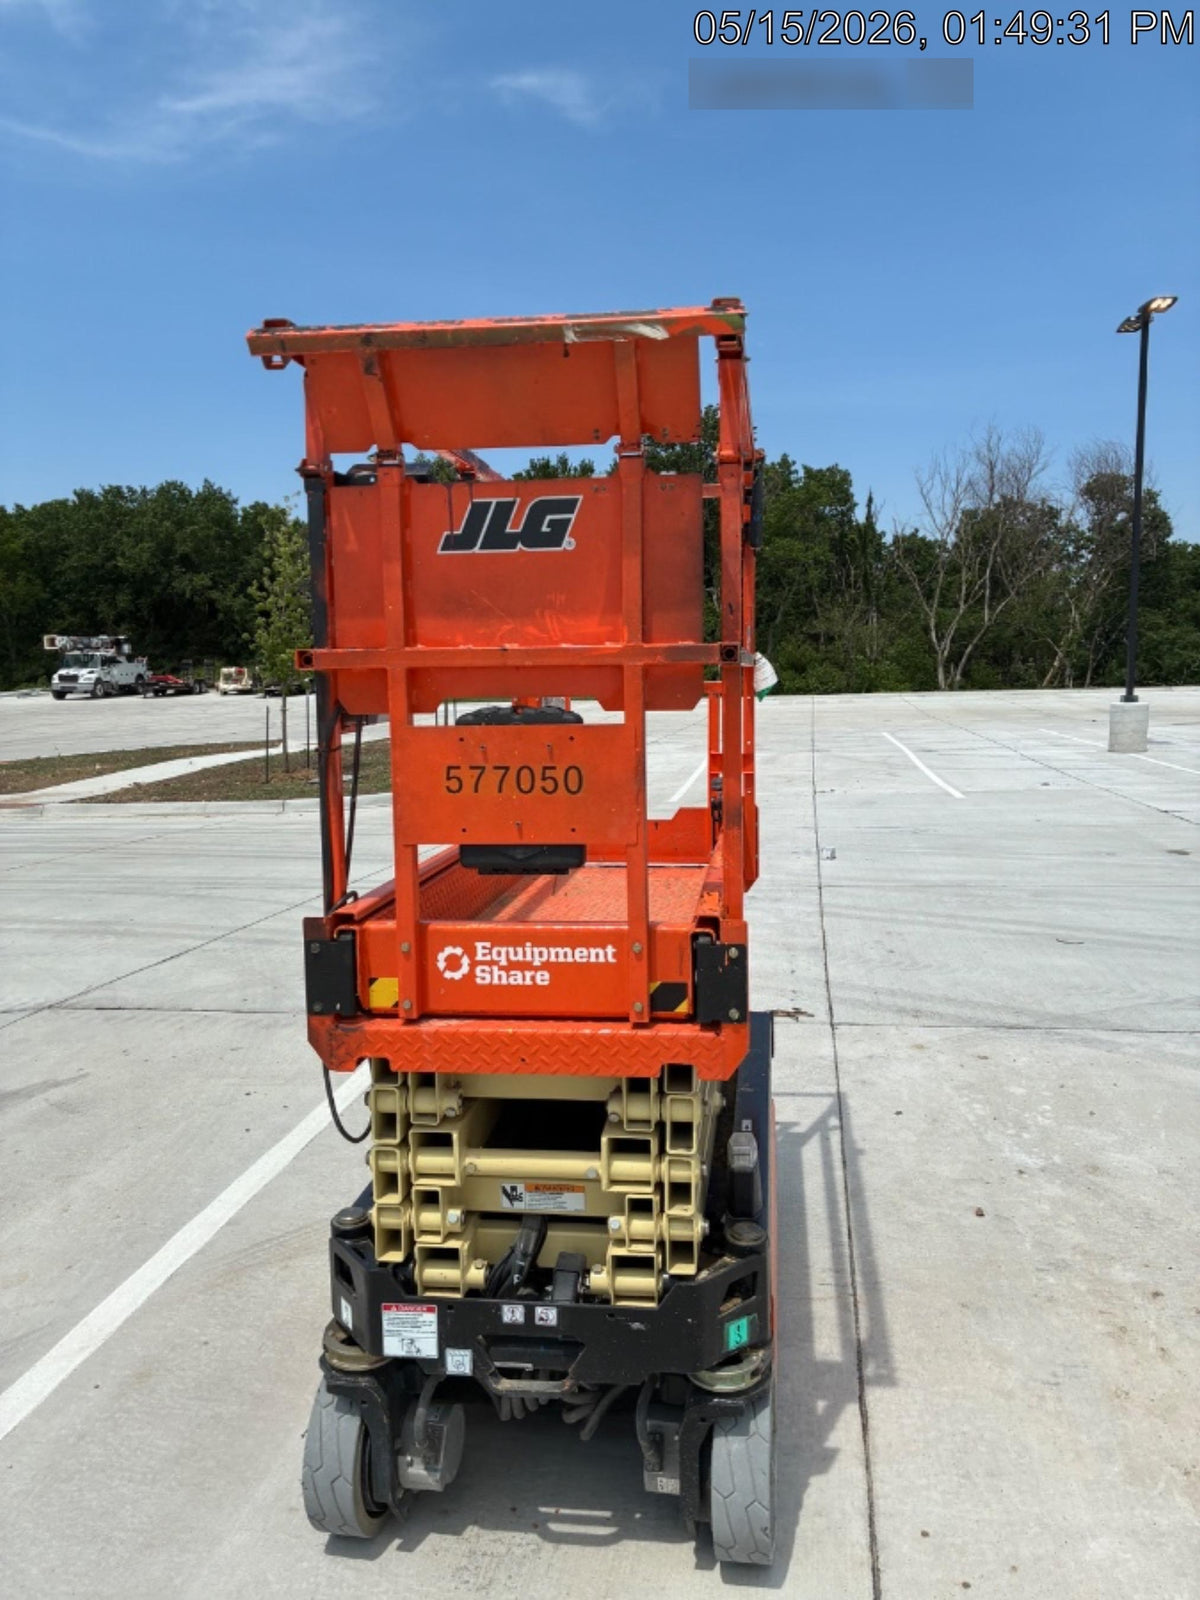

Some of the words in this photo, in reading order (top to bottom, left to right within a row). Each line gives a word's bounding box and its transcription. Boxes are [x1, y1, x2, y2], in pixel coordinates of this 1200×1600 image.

[437, 495, 583, 553] JLG
[445, 765, 584, 795] 577050
[474, 942, 617, 966] Equipment
[475, 965, 550, 986] Share
